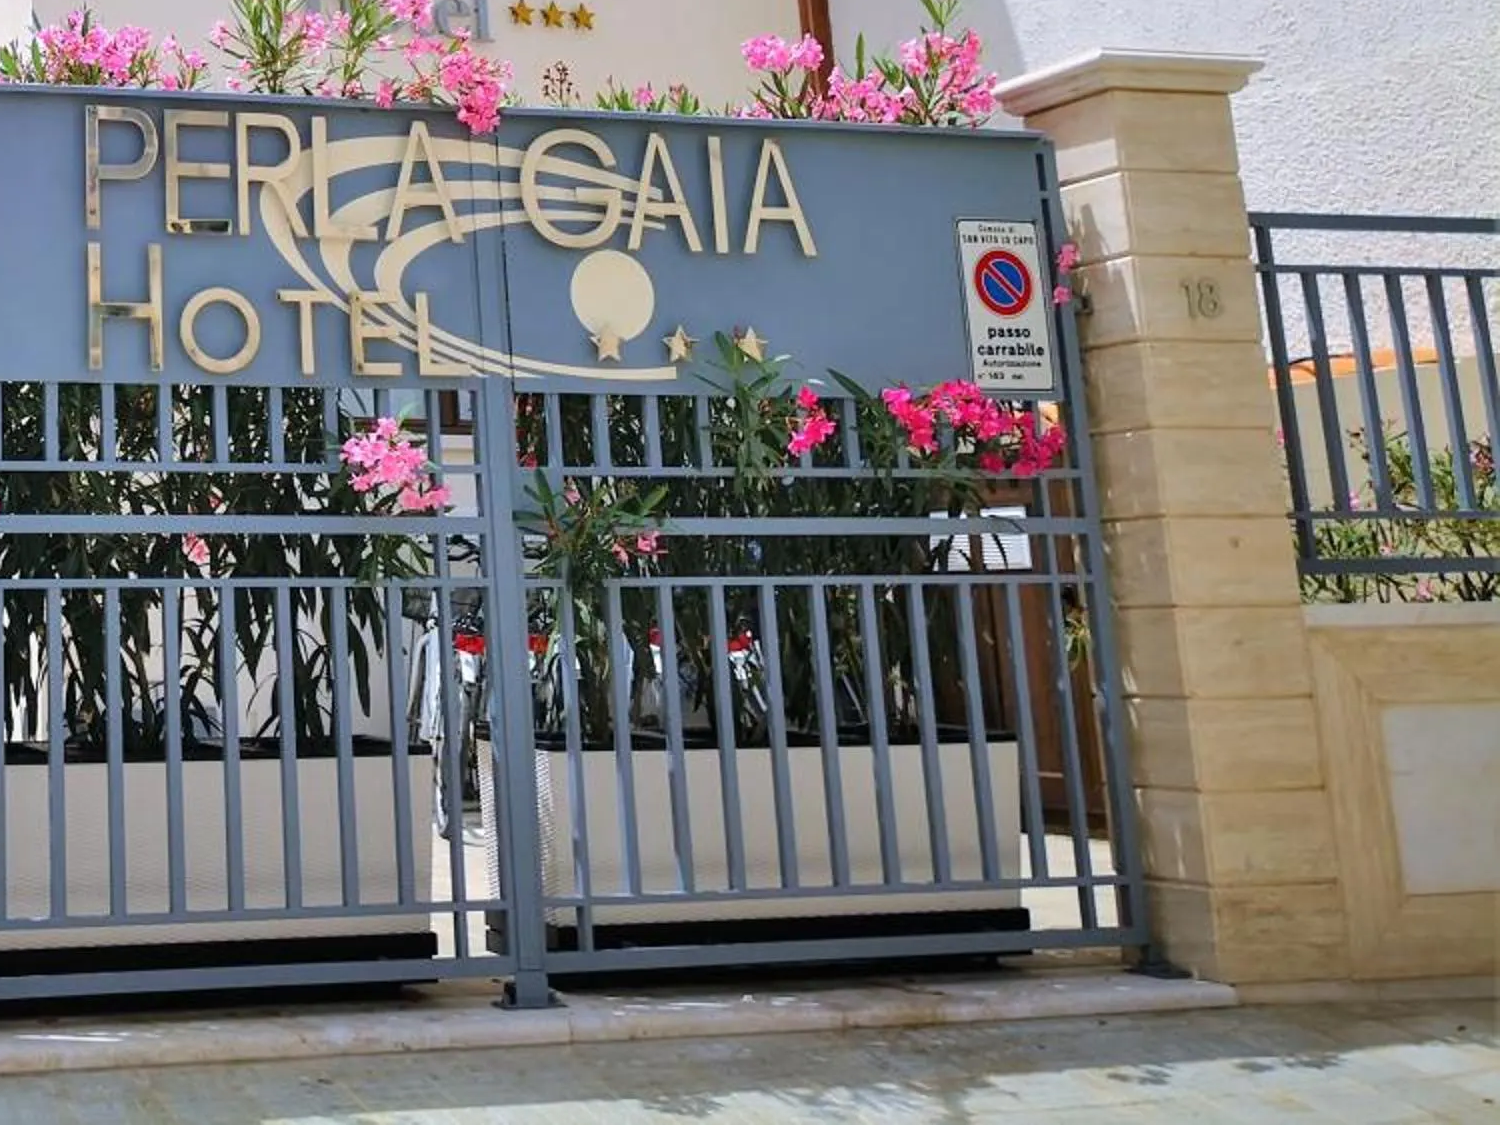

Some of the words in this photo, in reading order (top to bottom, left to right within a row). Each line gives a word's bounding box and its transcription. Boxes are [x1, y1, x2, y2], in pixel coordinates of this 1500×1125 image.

[85, 104, 464, 243] PERLA
[520, 128, 817, 257] GAIA
[87, 242, 472, 375] HOTEL
[1180, 277, 1222, 320] 18
[977, 343, 1044, 356] carrabile
[987, 326, 1031, 339] passo
